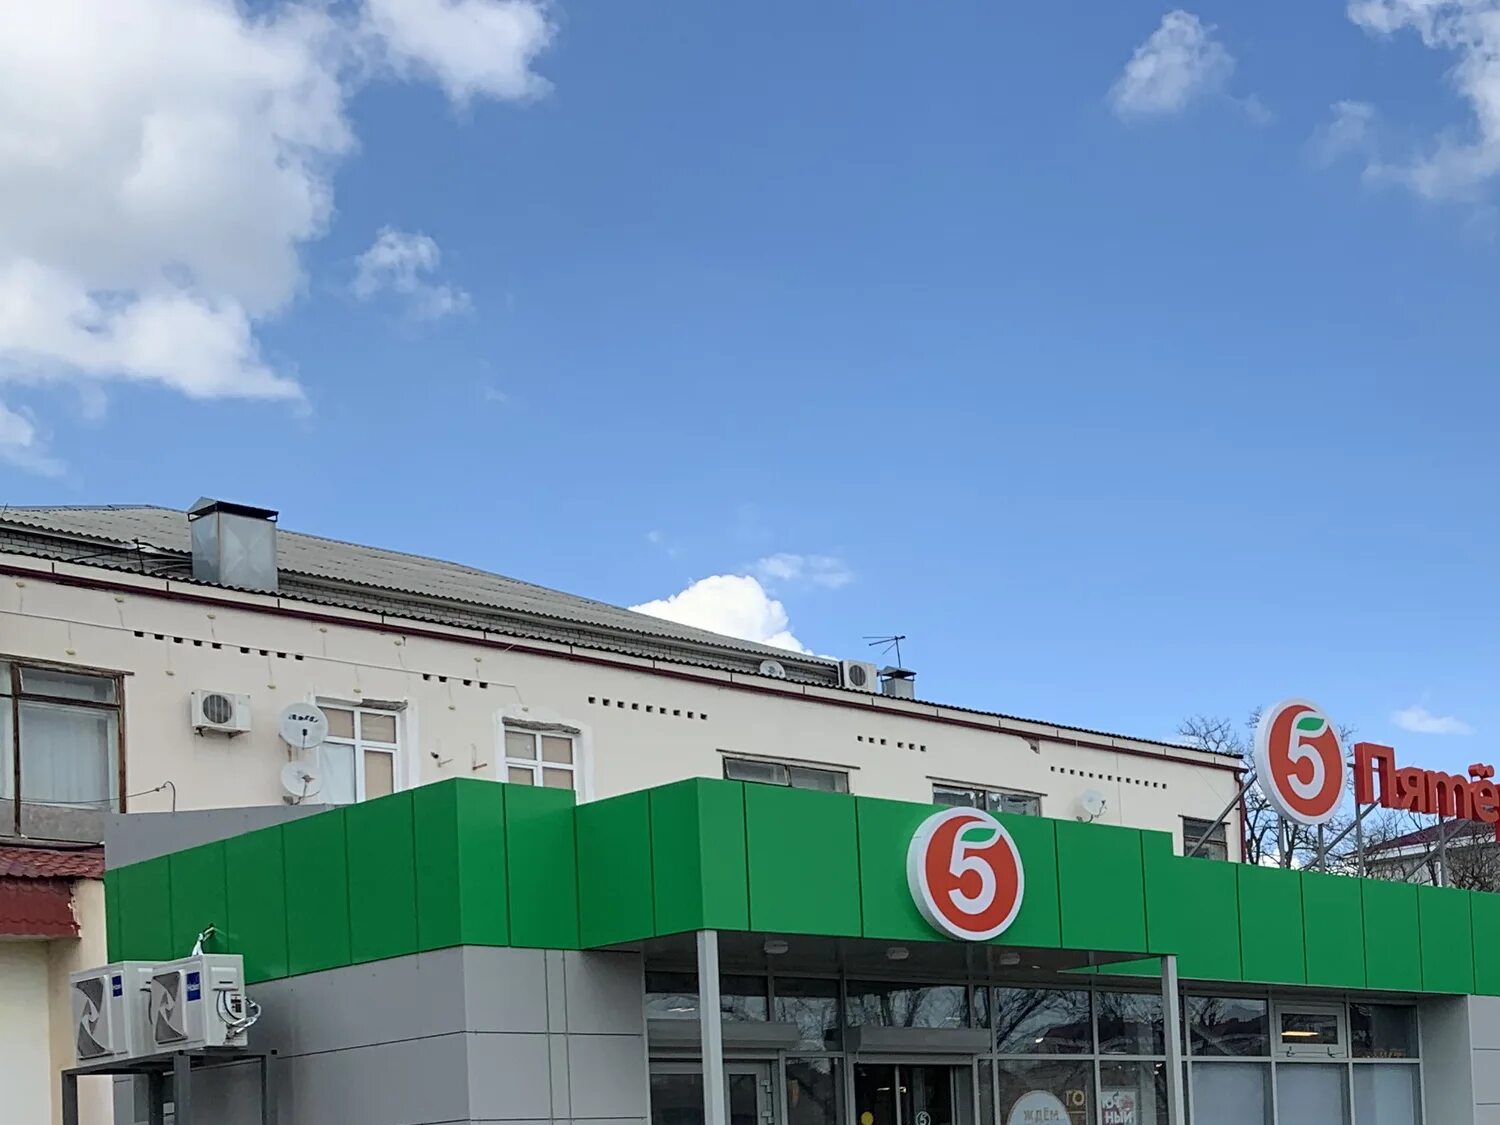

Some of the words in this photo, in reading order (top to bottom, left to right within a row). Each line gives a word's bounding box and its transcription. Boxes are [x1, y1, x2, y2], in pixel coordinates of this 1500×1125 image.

[1286, 710, 1329, 800] 5
[948, 821, 1002, 915] 5
[1023, 1107, 1060, 1122] ЖДЁМ
